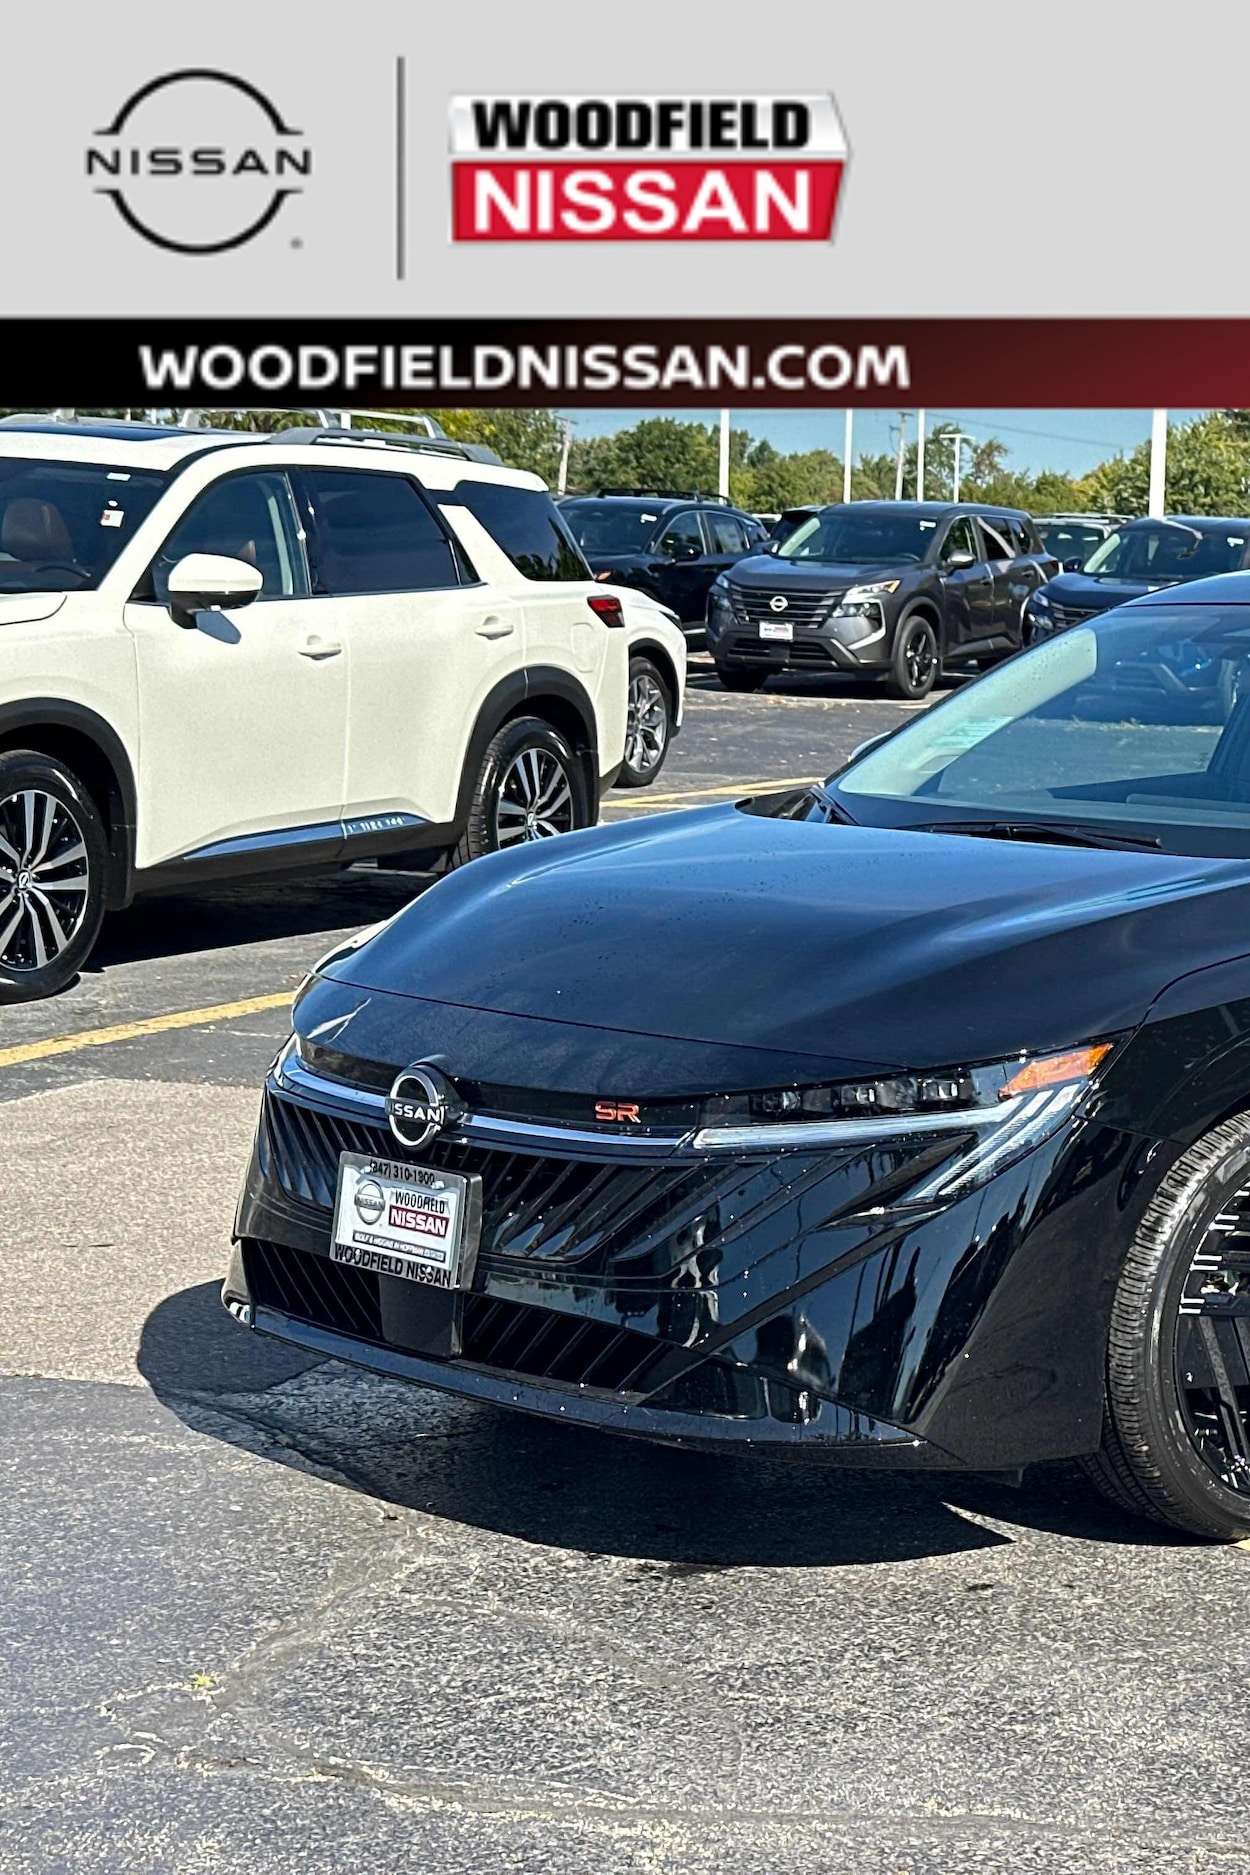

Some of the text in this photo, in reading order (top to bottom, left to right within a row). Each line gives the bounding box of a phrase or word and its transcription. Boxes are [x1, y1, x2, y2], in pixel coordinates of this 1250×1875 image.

[595, 1101, 642, 1123] SR
[393, 1168, 435, 1185] 310-1900
[395, 1190, 445, 1214] WOODFIELD
[390, 1208, 447, 1236] NISSAN
[335, 1243, 403, 1275] WOODFIELD
[405, 1262, 451, 1288] NISSAN
